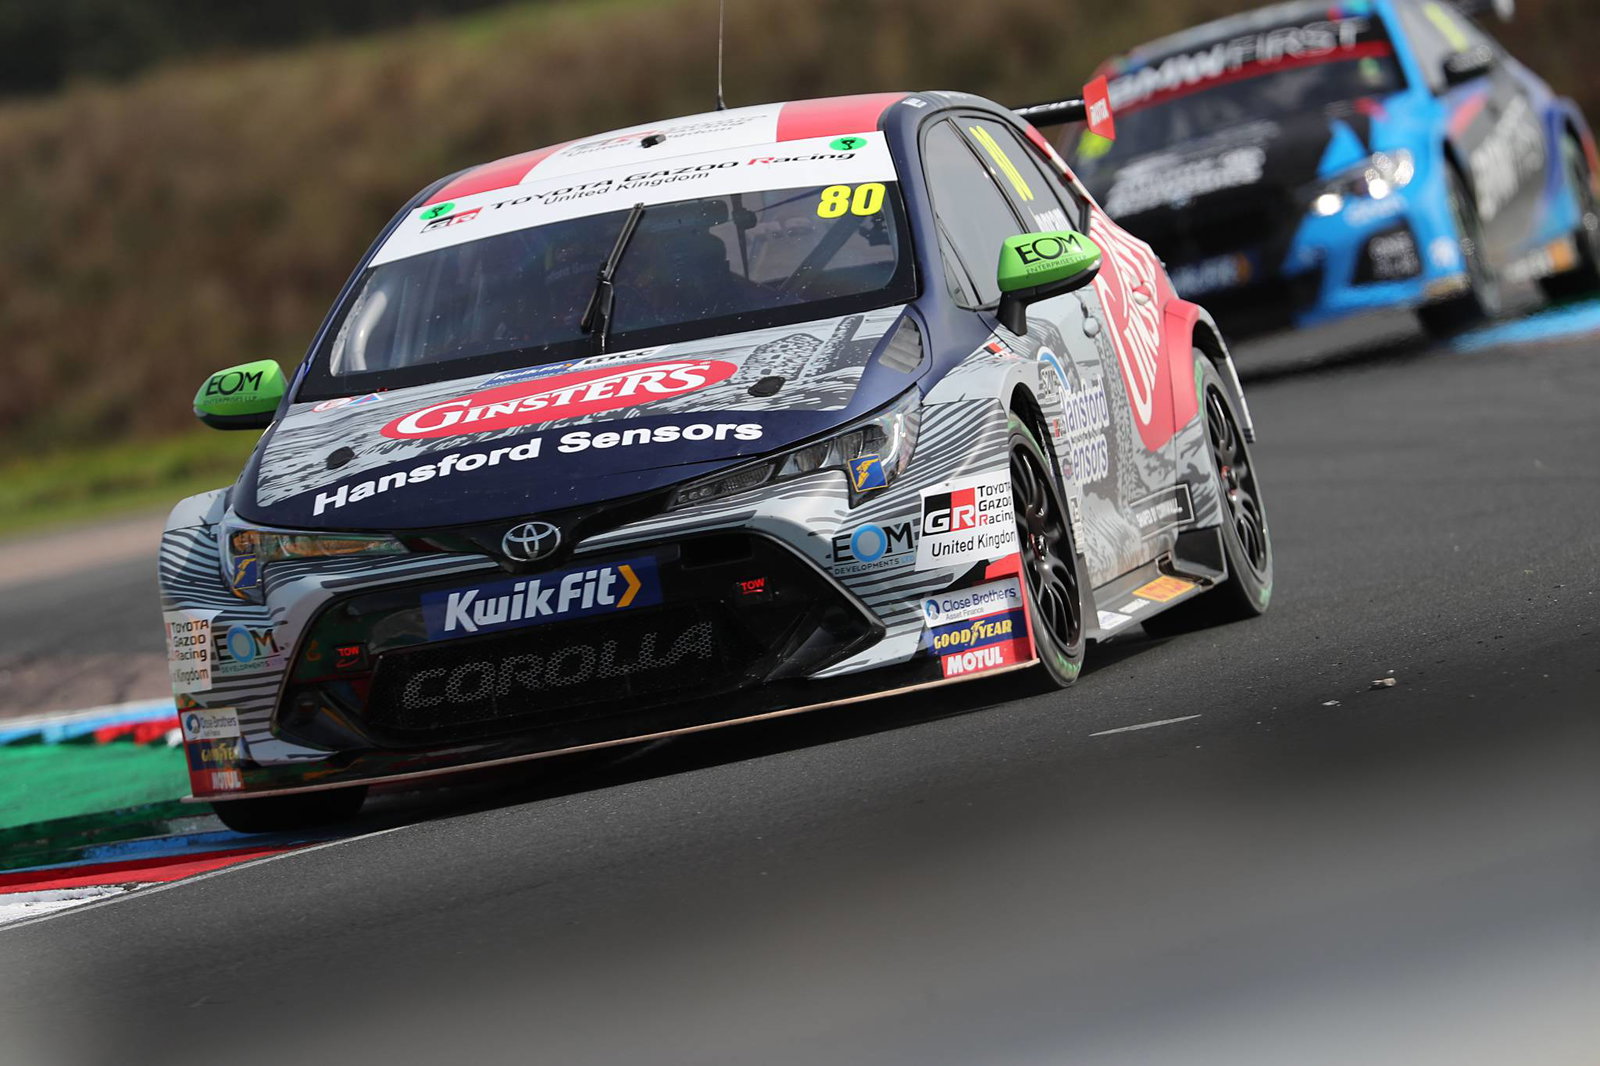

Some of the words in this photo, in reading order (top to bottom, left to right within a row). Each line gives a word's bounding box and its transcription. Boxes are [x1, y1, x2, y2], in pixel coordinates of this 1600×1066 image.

[492, 179, 613, 210] TOYOTA
[624, 161, 739, 182] GAZOO
[747, 152, 856, 166] Racing
[544, 187, 608, 205] United
[617, 172, 709, 190] Kingdom
[816, 182, 887, 219] 80
[1014, 233, 1083, 265] EOM
[583, 350, 650, 365] BTCC
[206, 370, 264, 396] EOM
[312, 438, 543, 516] Hansford
[557, 421, 764, 455] Sensors
[924, 504, 976, 534] GR
[832, 522, 914, 563] EOM
[931, 536, 974, 557] United
[834, 558, 900, 575] DEVELOPMENTS
[740, 578, 766, 592] TOW
[942, 598, 971, 613] Close
[971, 587, 1017, 603] Brothers
[171, 619, 209, 634] TOYOTA
[174, 634, 206, 648] GAZOO
[934, 619, 1013, 650] GOODYEAR
[214, 627, 280, 664] EOM
[338, 645, 360, 657] TOW
[402, 620, 713, 710] COROLLA
[947, 646, 1004, 676] MOTUL
